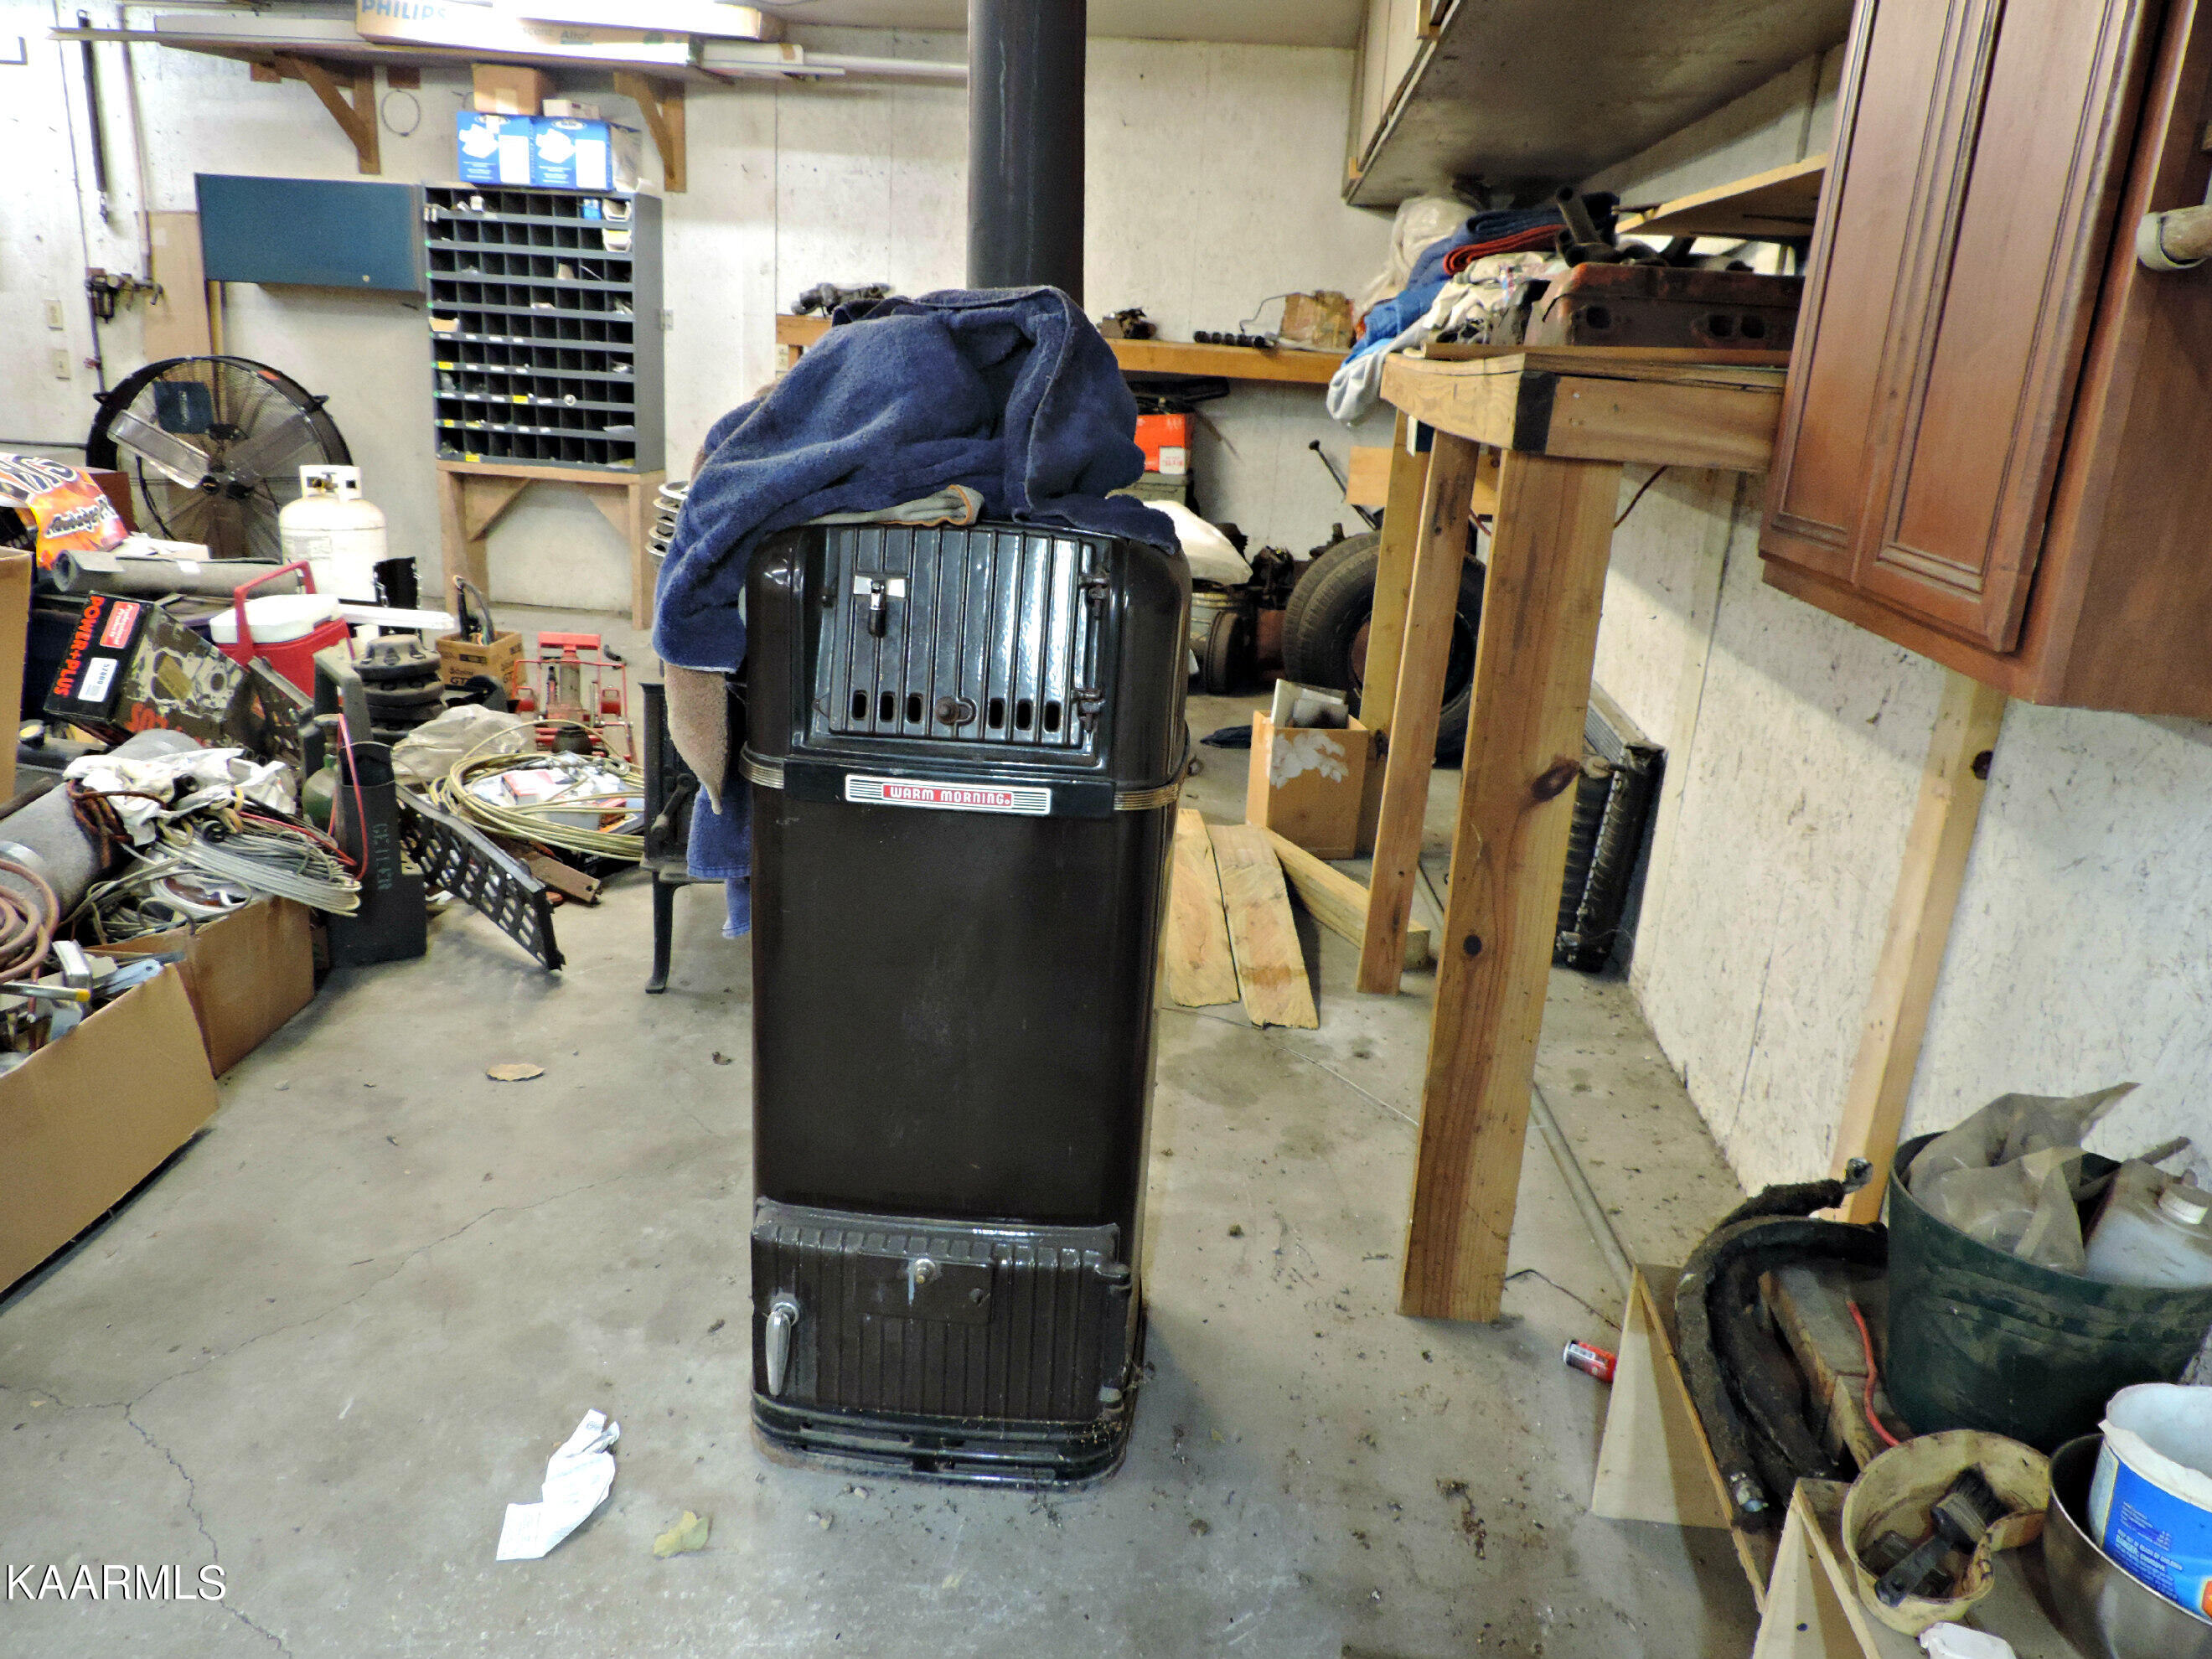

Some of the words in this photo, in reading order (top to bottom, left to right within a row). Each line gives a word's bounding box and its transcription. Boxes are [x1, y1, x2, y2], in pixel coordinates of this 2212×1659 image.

[361, 0, 447, 21] PHILIPS
[890, 787, 934, 801] WARM
[940, 790, 1004, 805] MORNING
